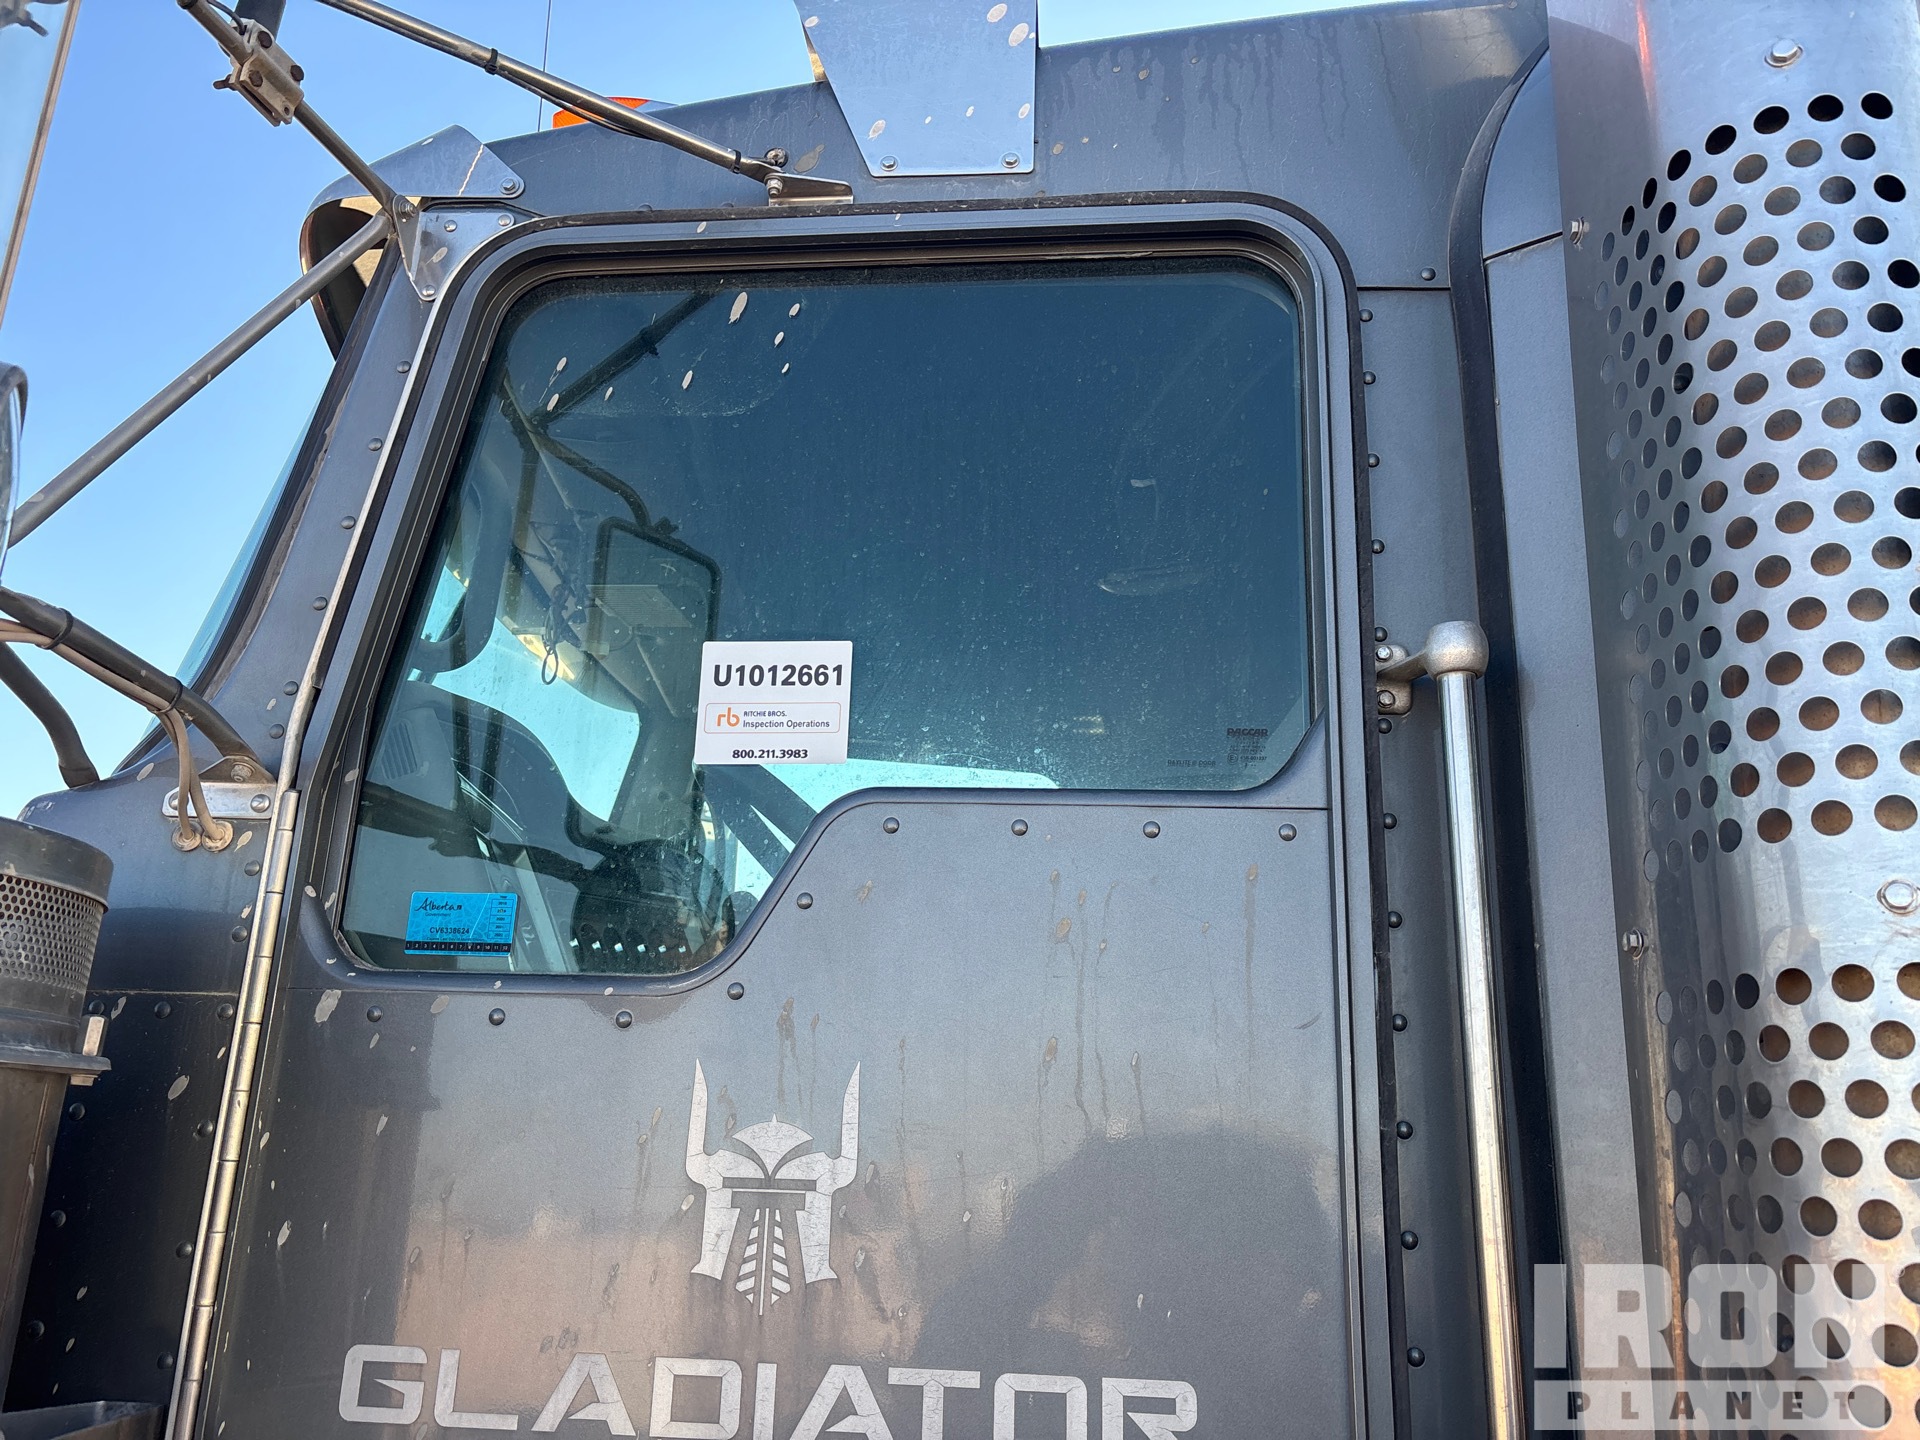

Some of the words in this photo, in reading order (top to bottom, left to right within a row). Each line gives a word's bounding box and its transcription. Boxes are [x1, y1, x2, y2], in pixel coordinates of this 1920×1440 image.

[713, 664, 843, 687] U1012661
[743, 719, 784, 730] Inspection
[786, 719, 830, 730] Operations
[1226, 727, 1269, 737] PACCAR
[732, 749, 809, 759] 800.211.3983
[414, 897, 460, 912] Alberta
[339, 1343, 1199, 1440] GLADIATOR
